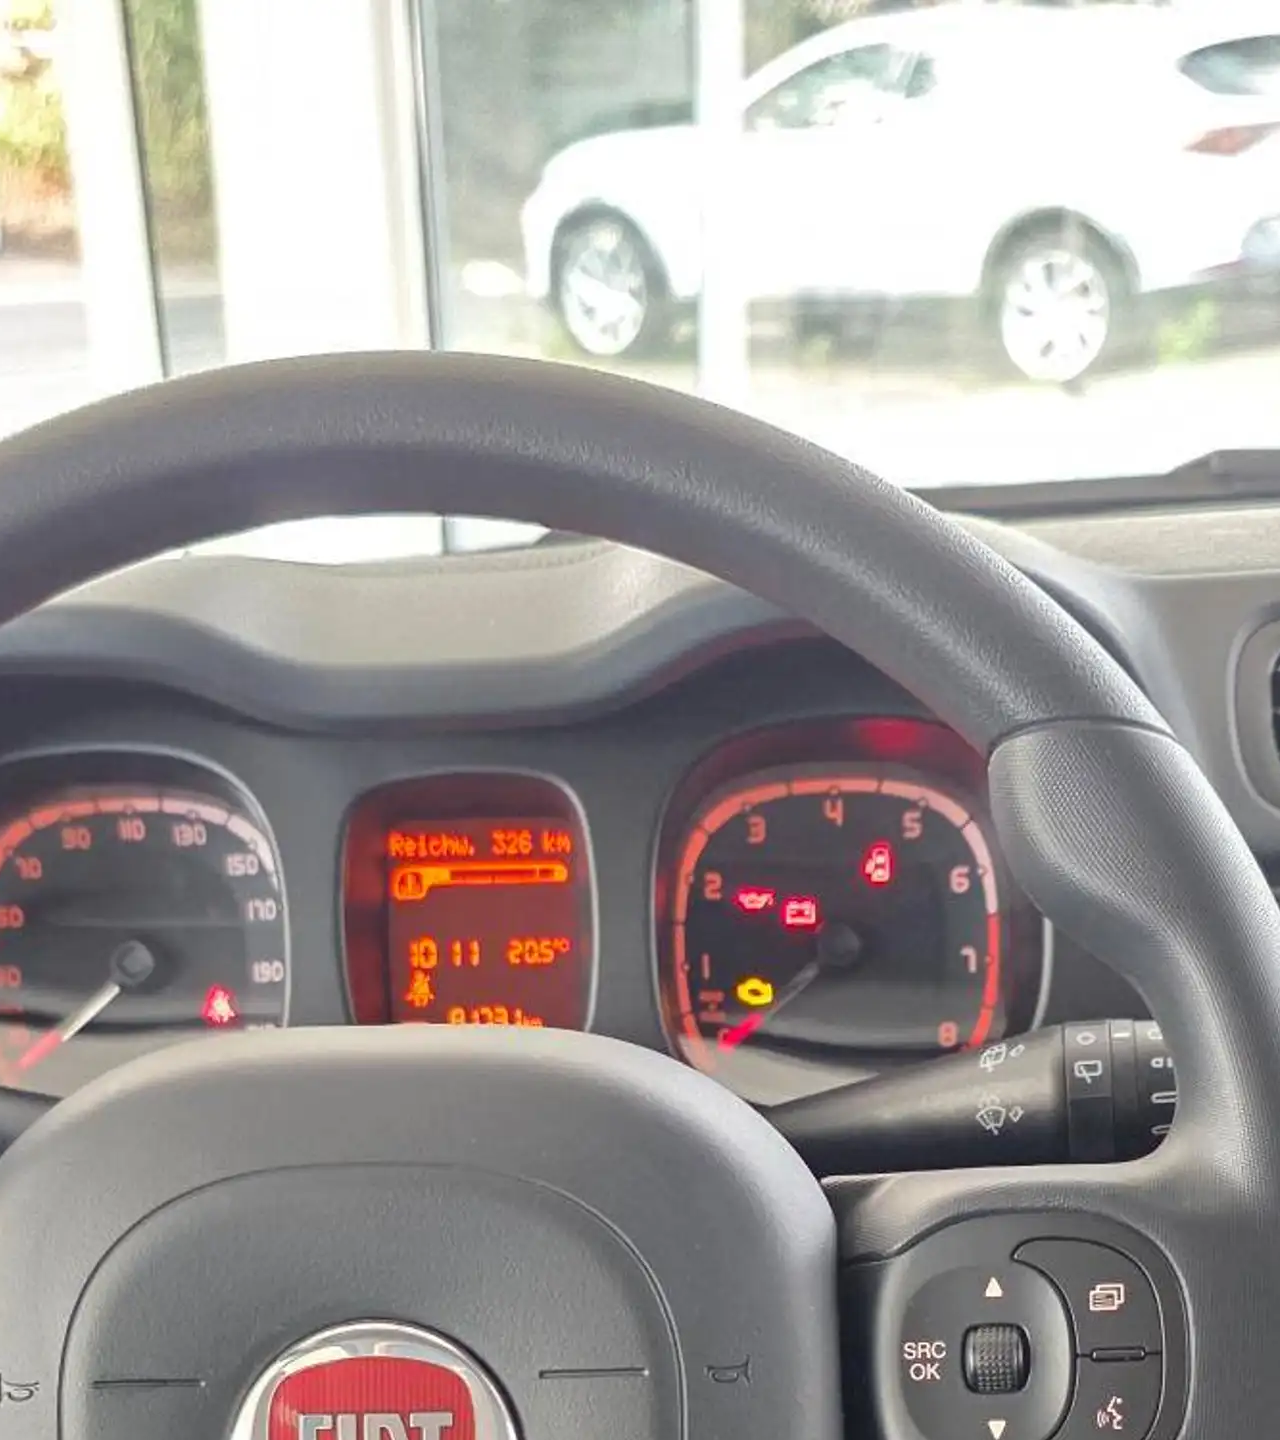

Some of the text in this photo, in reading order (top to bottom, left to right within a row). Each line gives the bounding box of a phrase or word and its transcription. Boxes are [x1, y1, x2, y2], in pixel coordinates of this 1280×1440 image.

[825, 800, 843, 825] 4
[902, 811, 922, 838] 5
[117, 821, 145, 840] 110
[747, 816, 766, 842] 3
[543, 831, 570, 854] km
[226, 855, 258, 876] 150
[704, 872, 722, 899] 2
[949, 866, 970, 893] 6
[252, 961, 284, 983] 190
[961, 948, 976, 973] 7
[903, 1342, 946, 1361] SRC
[910, 1363, 941, 1381] OK
